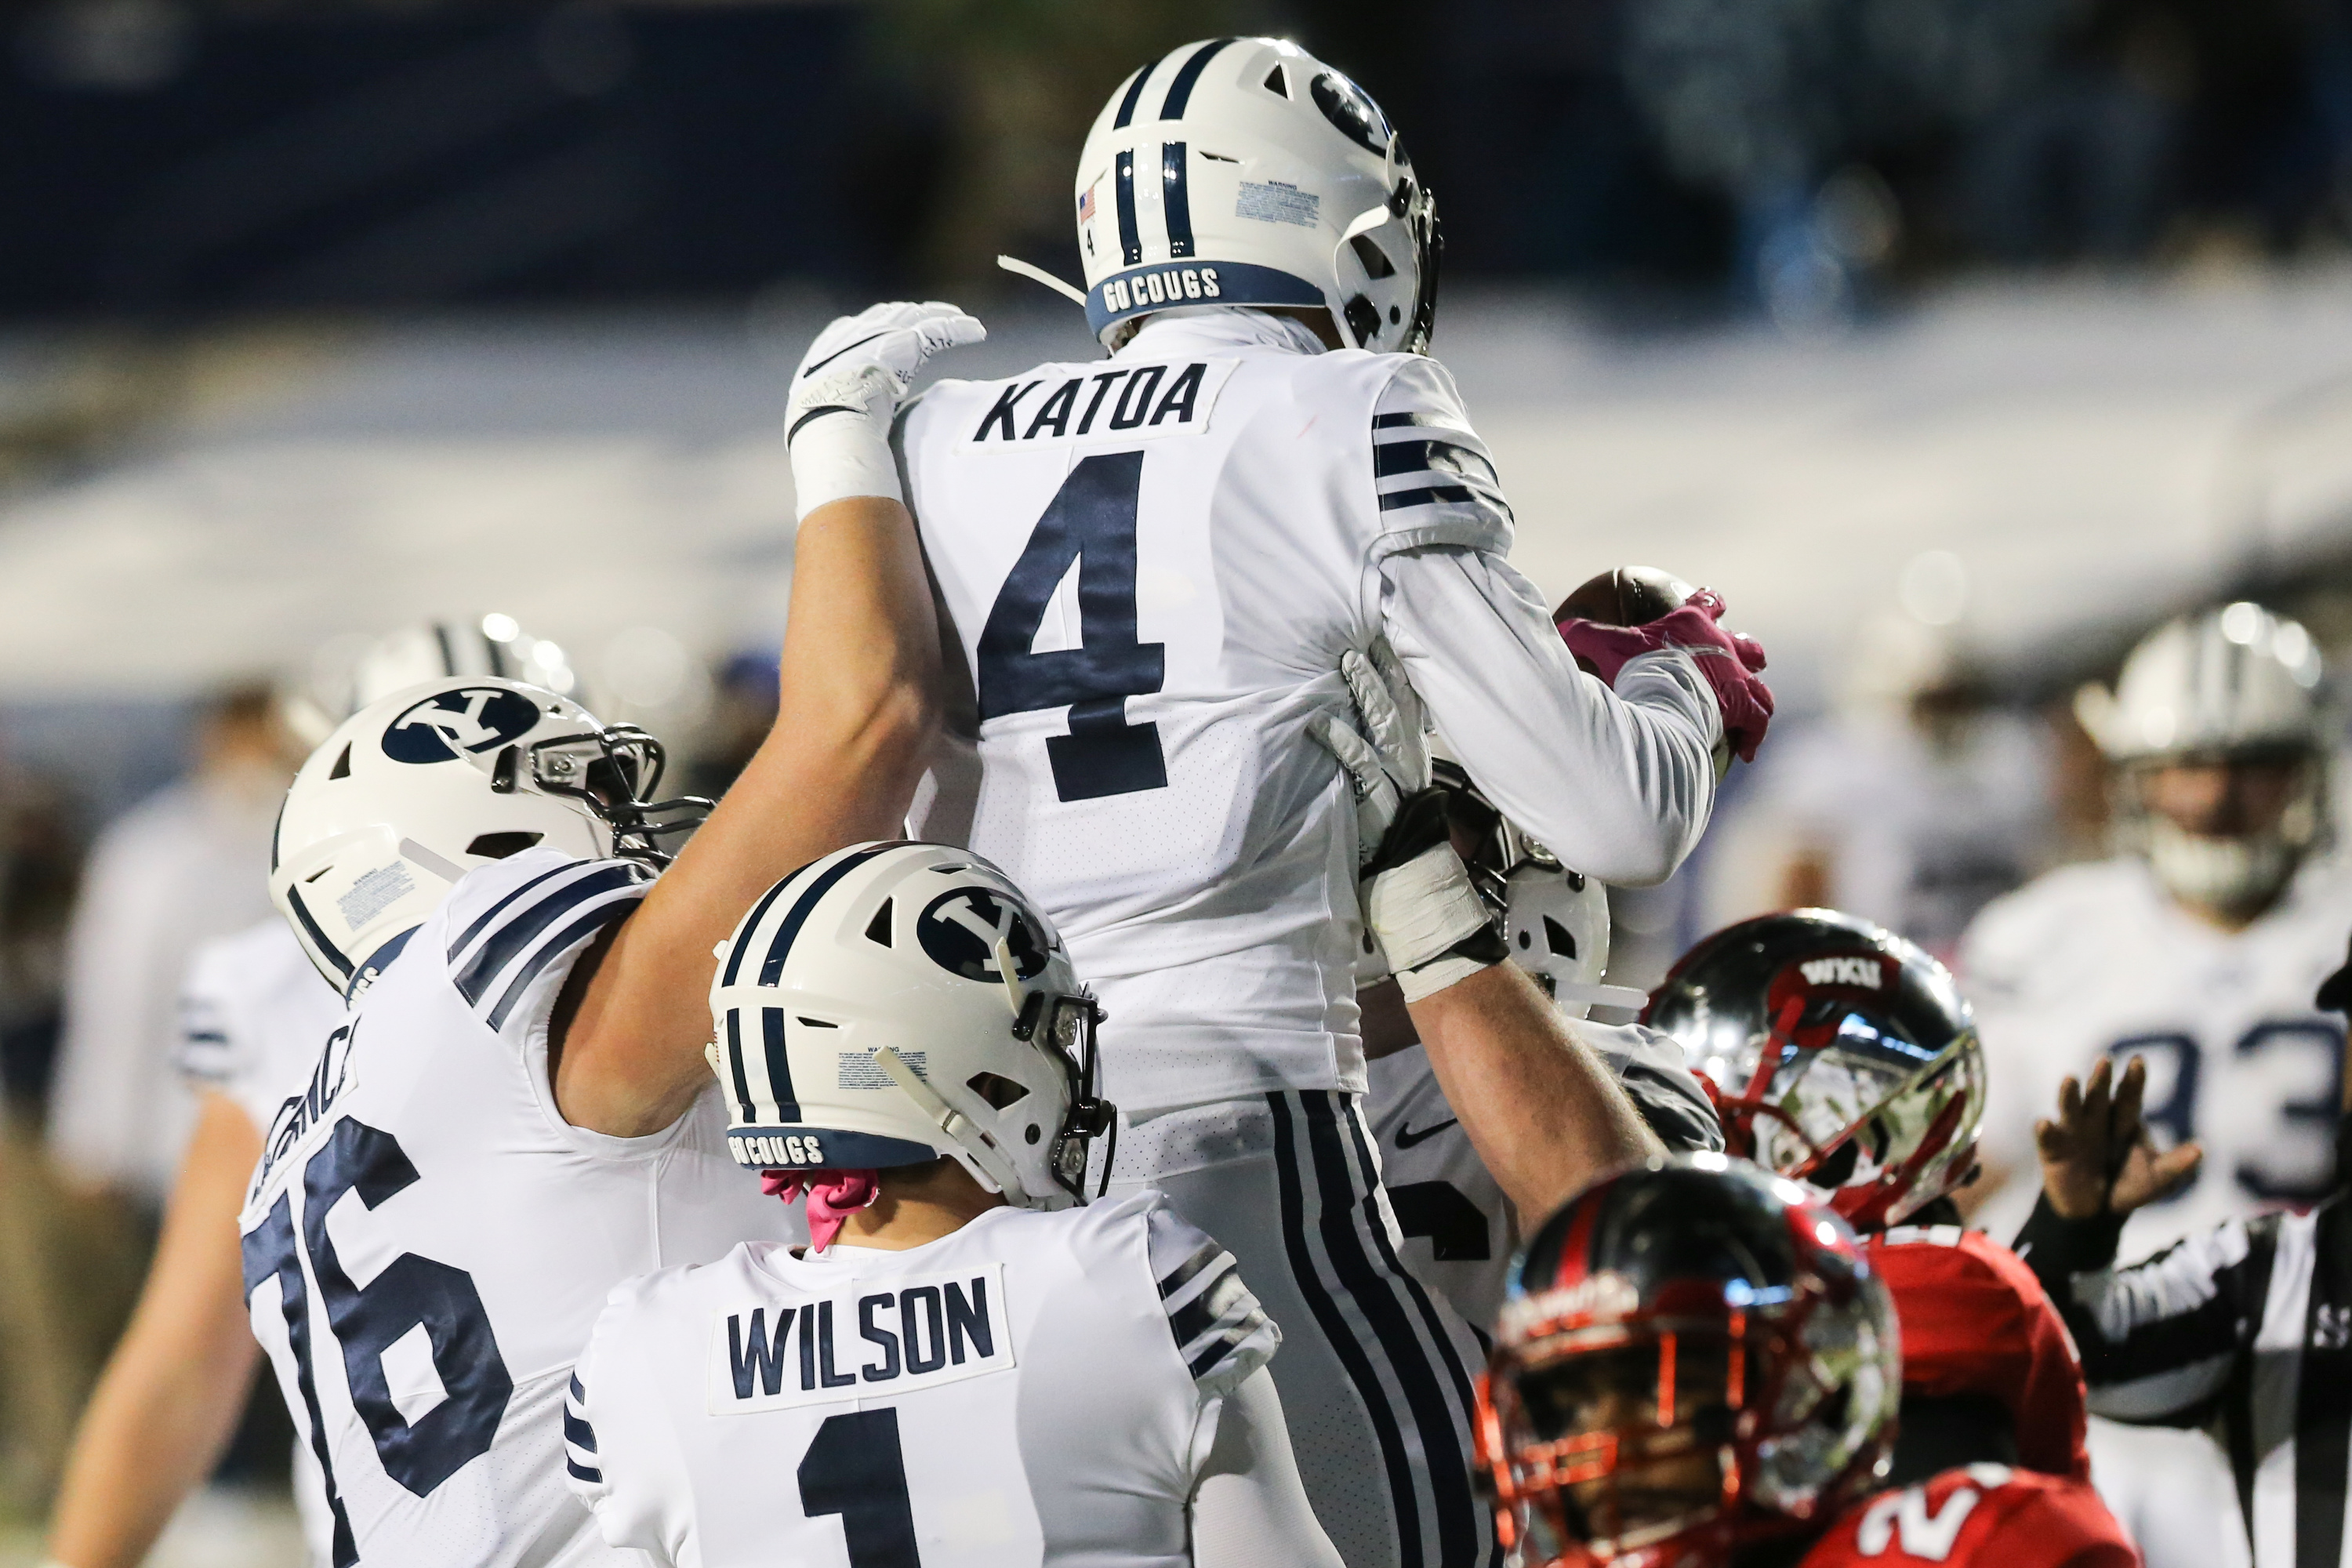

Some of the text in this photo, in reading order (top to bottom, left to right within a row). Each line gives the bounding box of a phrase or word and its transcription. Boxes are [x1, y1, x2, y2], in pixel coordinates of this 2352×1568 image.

[1087, 228, 1095, 257] 4
[1102, 267, 1221, 314] GO COUGS
[973, 363, 1207, 442] KATOA
[977, 450, 1168, 803] 4
[394, 690, 504, 749] Y
[932, 895, 1024, 972] Y
[1799, 956, 1882, 990] WKU
[745, 1136, 825, 1165] COUGS
[241, 1114, 514, 1568] 76
[728, 1276, 995, 1399] WILSON
[797, 1406, 922, 1568] 1
